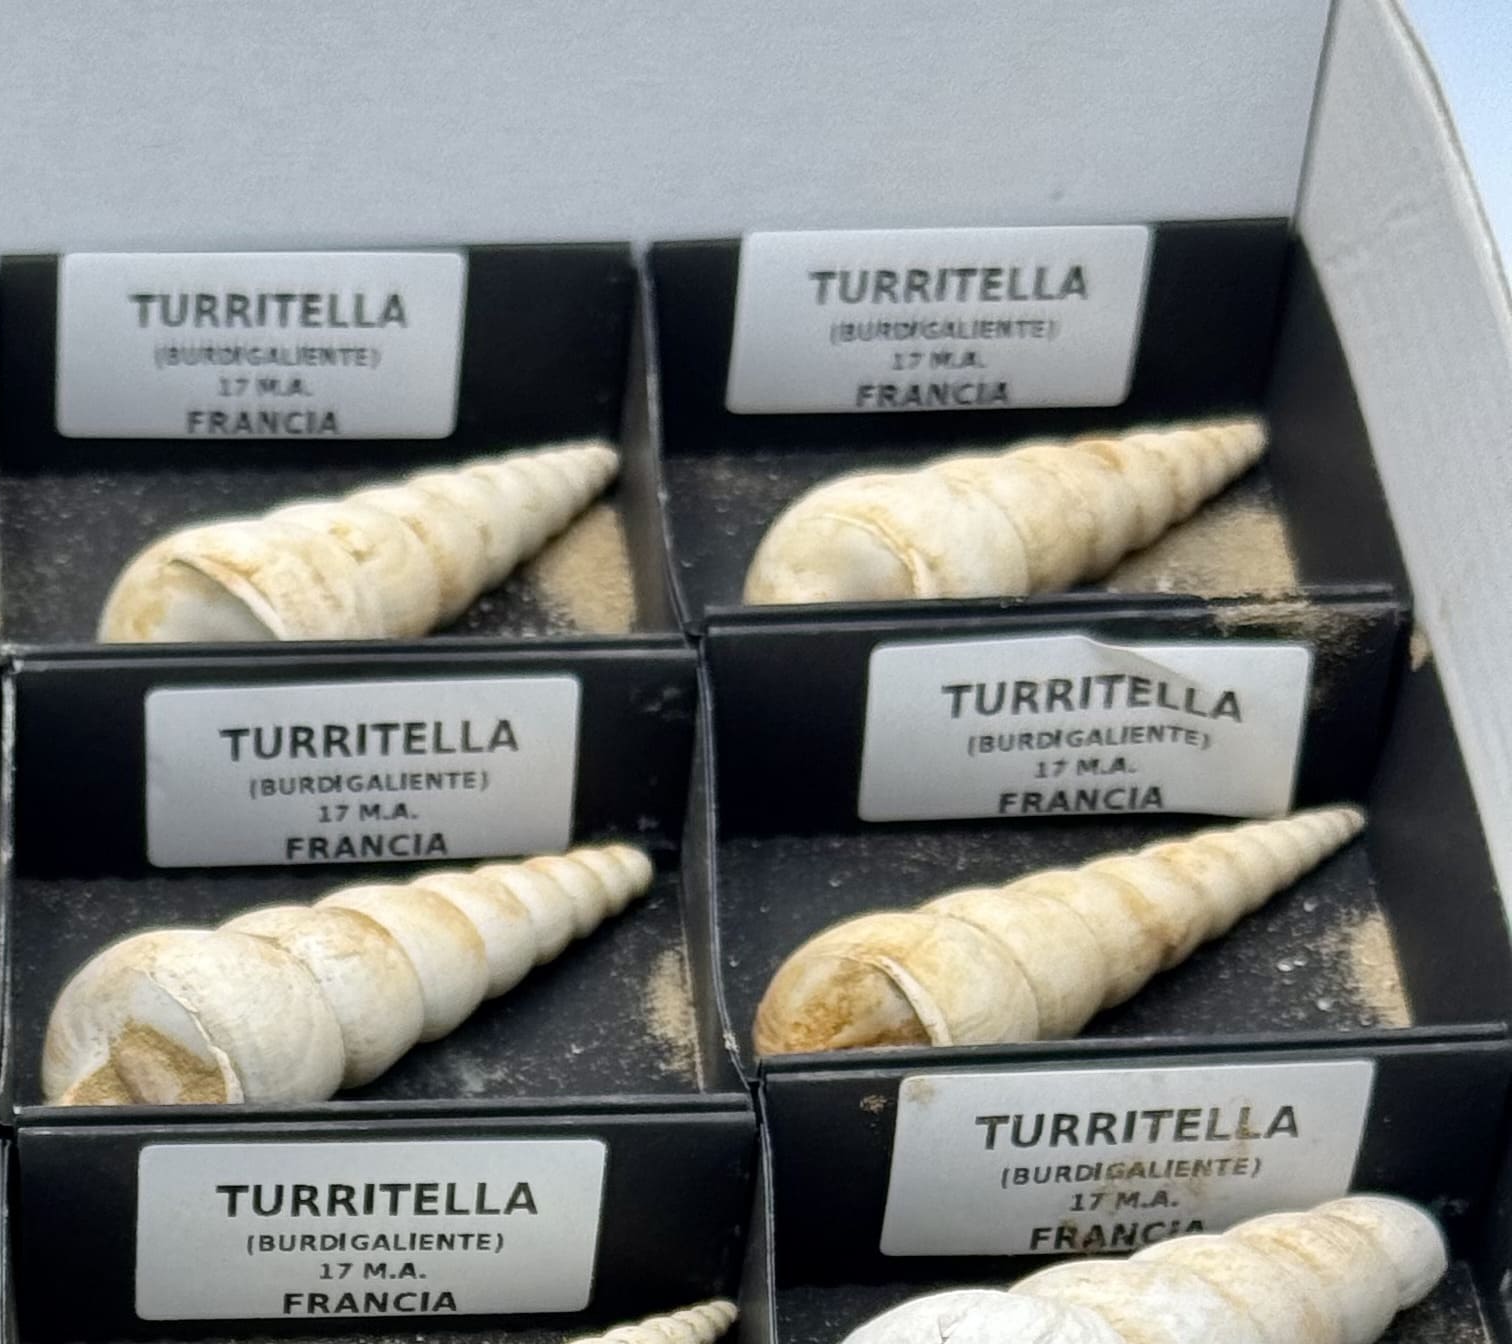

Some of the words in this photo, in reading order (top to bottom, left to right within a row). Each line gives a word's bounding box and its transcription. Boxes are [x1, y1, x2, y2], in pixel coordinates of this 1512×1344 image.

[809, 266, 1087, 305] TURRITELLA
[130, 293, 407, 328] TURRITELLA
[830, 318, 1059, 343] (BURDIGALIENTE)
[155, 345, 380, 368] (BURDIGALIENTE)
[892, 351, 922, 371] 17
[219, 379, 249, 396] 17
[856, 382, 1009, 408] FRANCIA
[187, 410, 341, 435] FRANCIA
[942, 674, 1242, 722] TURRITELLA
[220, 720, 519, 762] TURRITELLA
[968, 726, 1210, 757] (BURDIGALIENTE)
[1035, 760, 1067, 780] 17
[1077, 756, 1136, 778] M.A.
[250, 771, 490, 798] (BURDIGALIENTE)
[318, 805, 349, 823] 17
[359, 803, 419, 823] M.A.
[998, 786, 1164, 816] FRANCIA
[285, 833, 448, 861] FRANCIA
[976, 1105, 1299, 1149] TURRITELLA
[1001, 1155, 1262, 1188] (BURDIGALIENTE)
[216, 1182, 537, 1219] TURRITELLA
[1070, 1192, 1104, 1211] 17
[1116, 1190, 1178, 1210] M.A.
[246, 1232, 503, 1255] (BURDIGALIENTE)
[319, 1263, 352, 1280] 17
[364, 1263, 427, 1280] M.A.
[283, 1291, 458, 1315] FRANCIA
